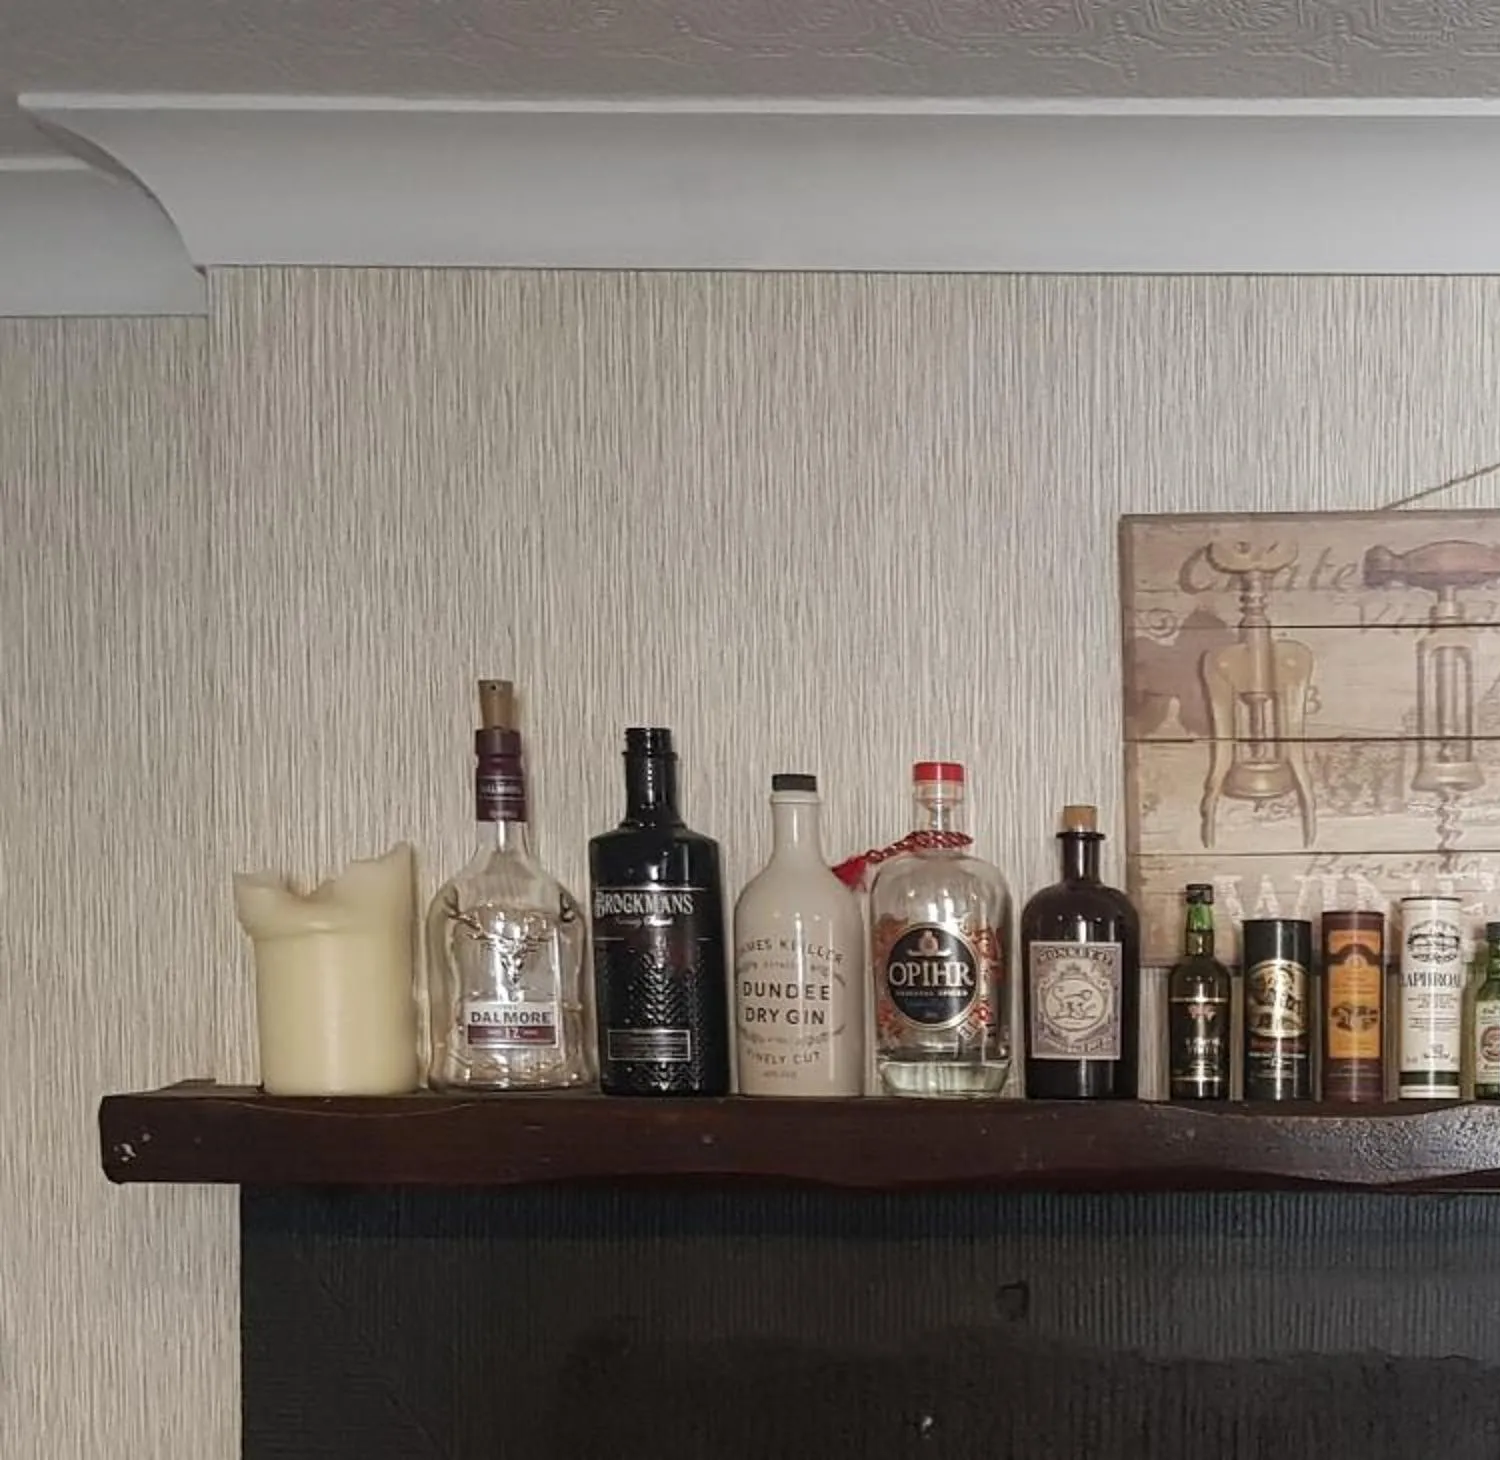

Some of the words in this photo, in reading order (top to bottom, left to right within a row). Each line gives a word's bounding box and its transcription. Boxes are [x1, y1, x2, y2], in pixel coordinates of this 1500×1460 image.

[889, 961, 975, 987] OPIHR
[743, 981, 831, 1001] DUNDEE
[471, 1011, 552, 1025] DALMORE
[745, 1007, 780, 1023] DRY
[786, 1009, 825, 1025] GIN
